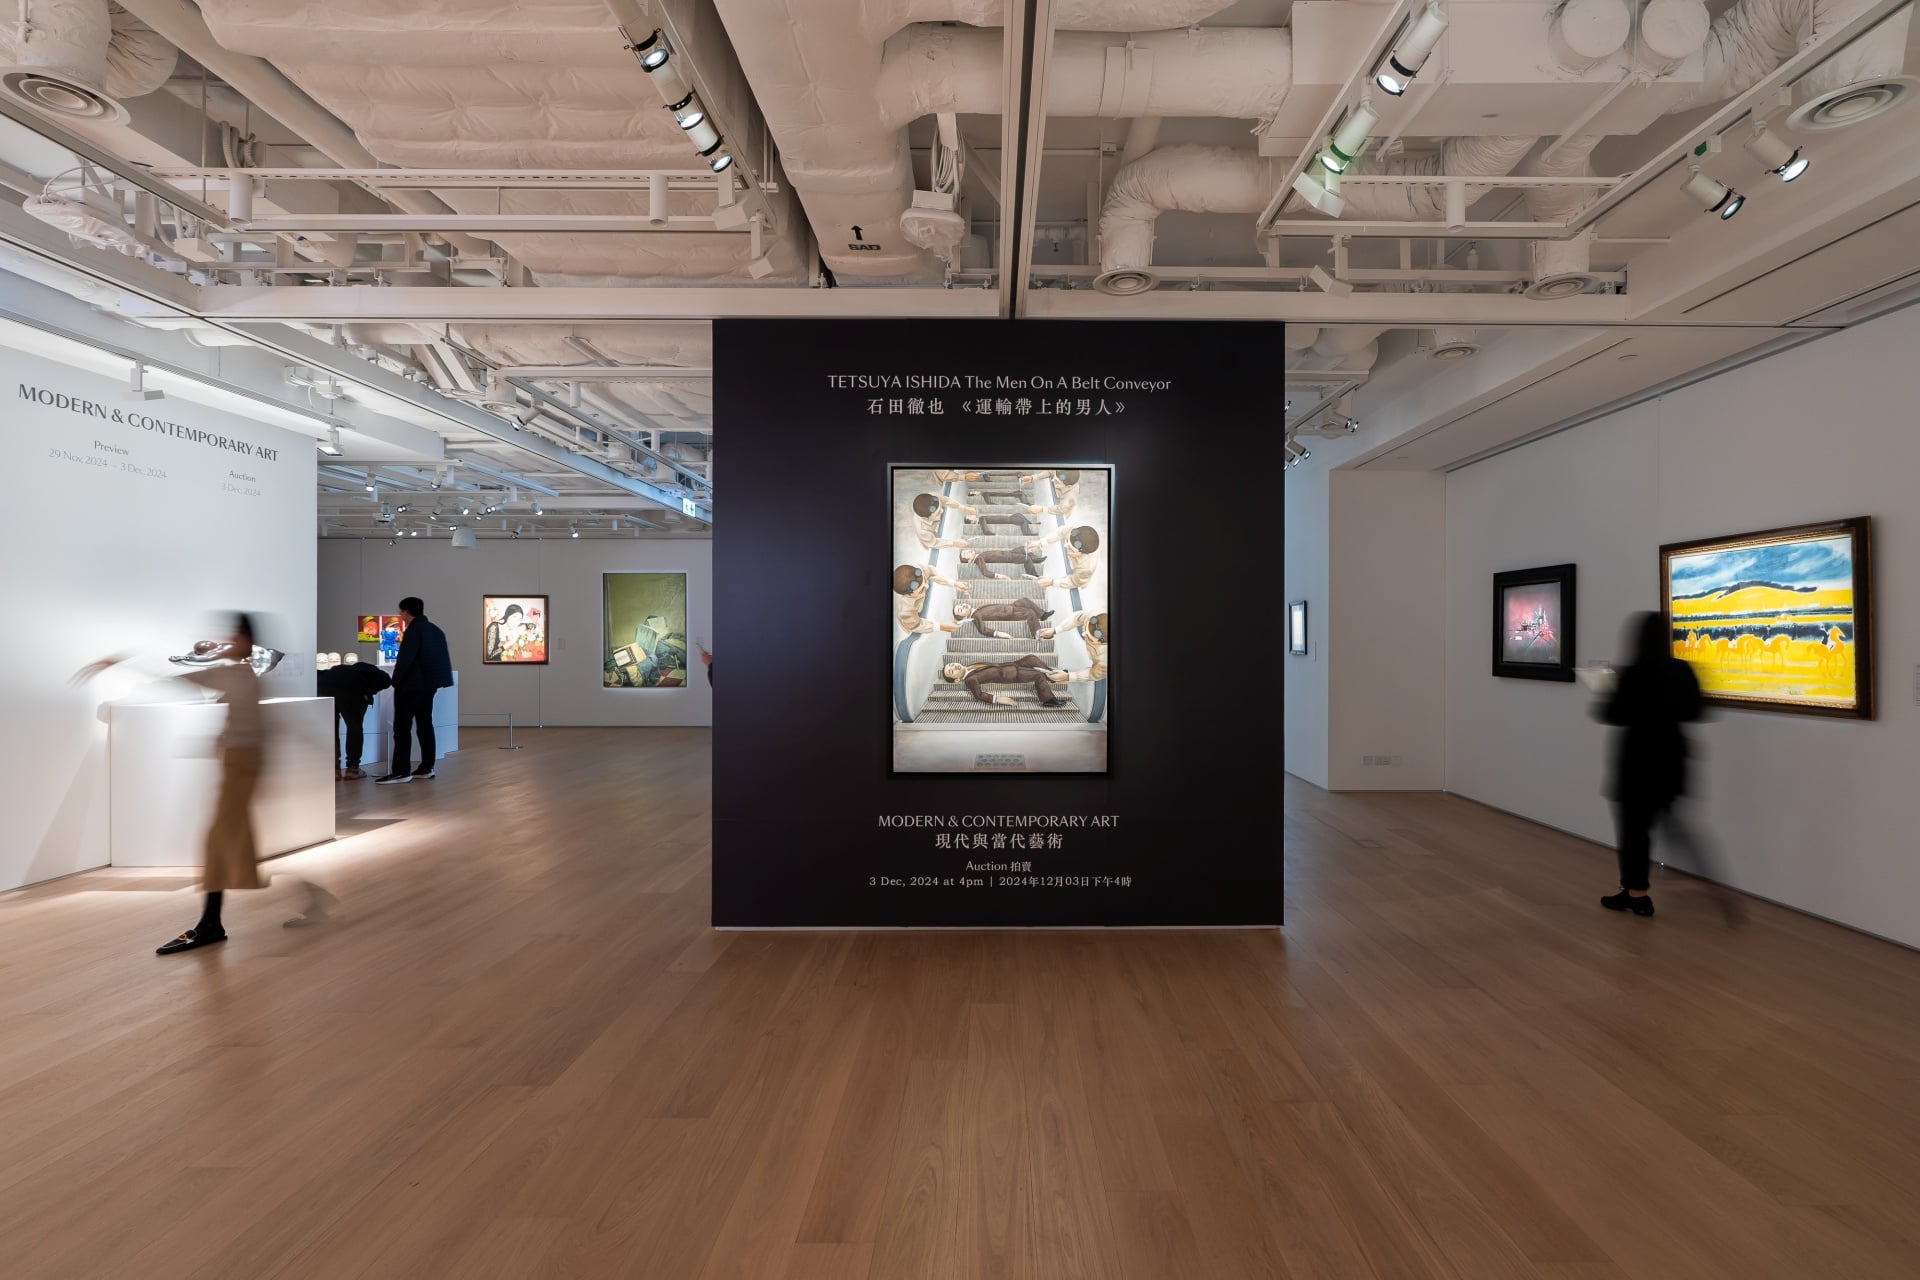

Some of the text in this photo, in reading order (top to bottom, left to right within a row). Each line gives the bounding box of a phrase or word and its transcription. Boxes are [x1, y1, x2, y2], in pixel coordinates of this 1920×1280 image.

[828, 375, 1171, 392] TETSUYA ISHIDA The Men On A Belt Conveyor
[868, 398, 1125, 415] 石田徹也 《運輸帶上的男人》
[19, 383, 279, 462] MODERN & CONTEMPORARY ART
[93, 439, 130, 456] Preview
[48, 447, 62, 459] 29
[84, 455, 108, 468] 2024
[120, 462, 127, 472] 3
[146, 467, 168, 479] 2024
[228, 469, 257, 483] Auction
[243, 487, 261, 497] 2024
[879, 816, 1119, 827] MODERN & CONTEMPORARY ART
[936, 833, 1062, 848] 現代與當代藝術
[966, 861, 1031, 872] Auction 拍賣
[869, 876, 877, 886] 3
[881, 877, 905, 887] Dec,
[911, 877, 938, 885] 2024
[960, 877, 983, 887] 4pm
[1000, 876, 1131, 887] 2024年12月03日下午4時
